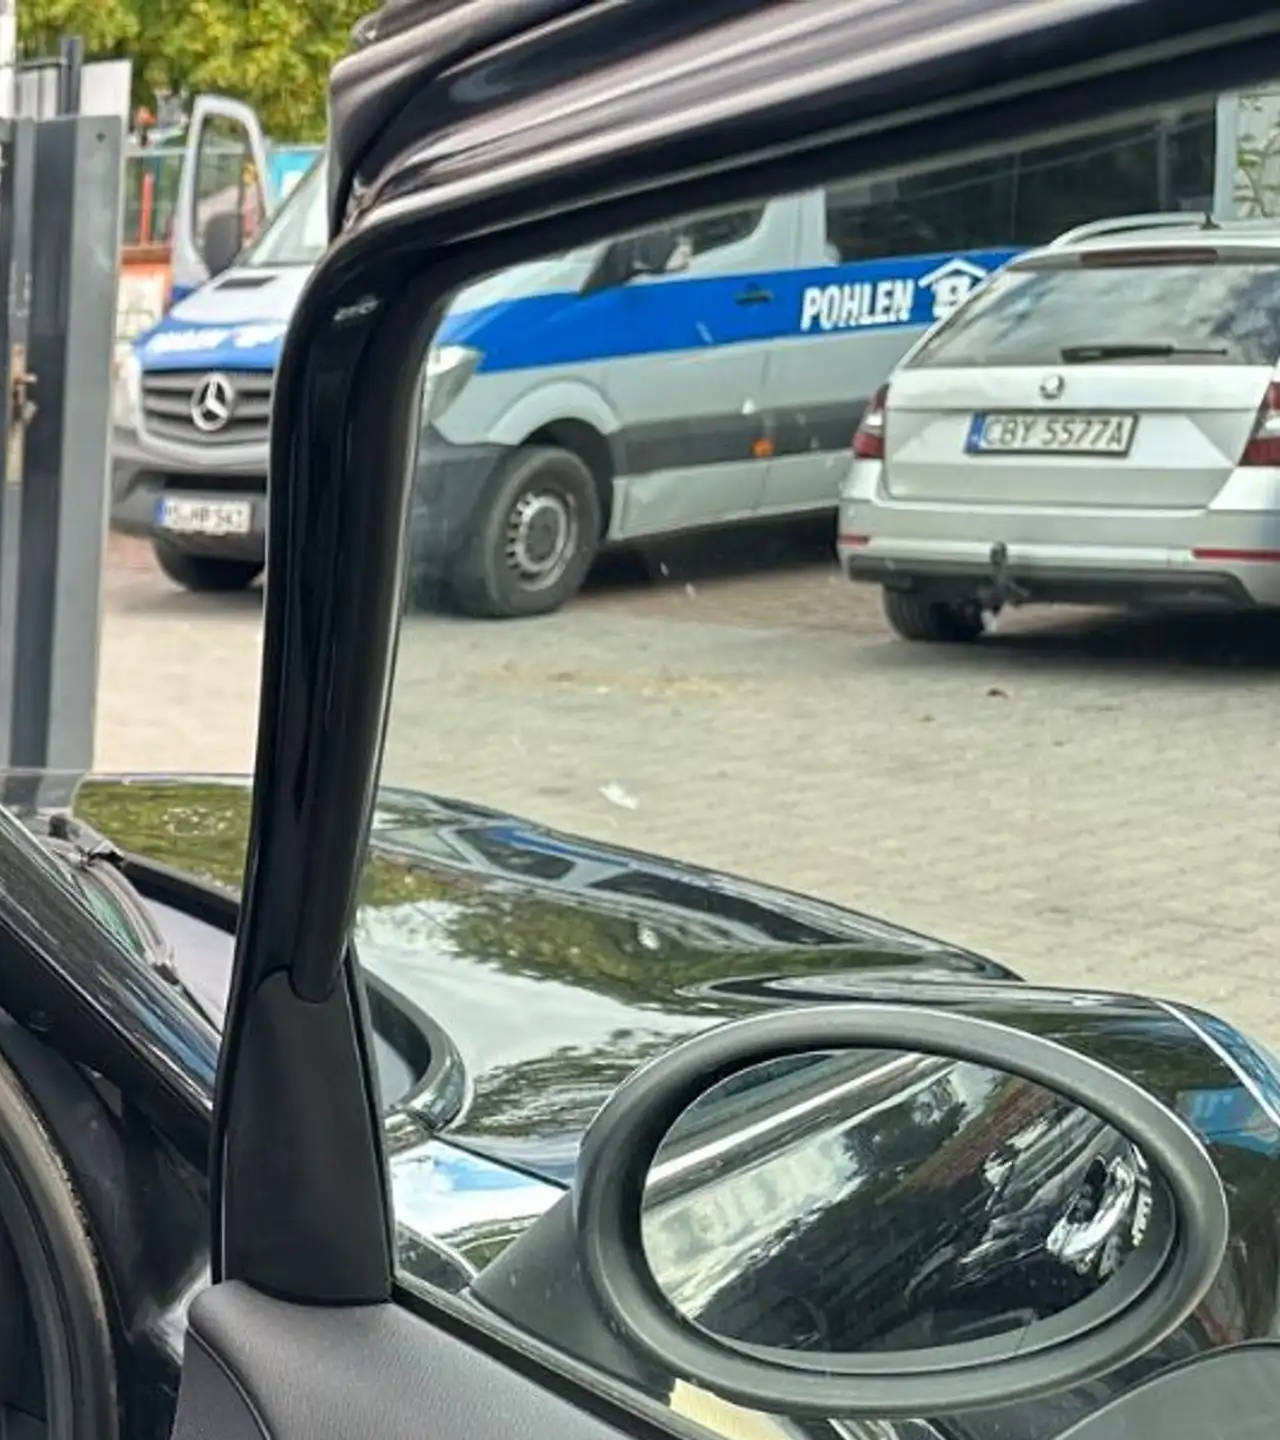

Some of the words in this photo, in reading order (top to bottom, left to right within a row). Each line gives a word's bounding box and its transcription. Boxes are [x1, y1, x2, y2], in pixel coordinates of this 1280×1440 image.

[800, 279, 915, 332] POHLEN
[983, 418, 1037, 447] CBY
[1041, 418, 1124, 447] 5577A
